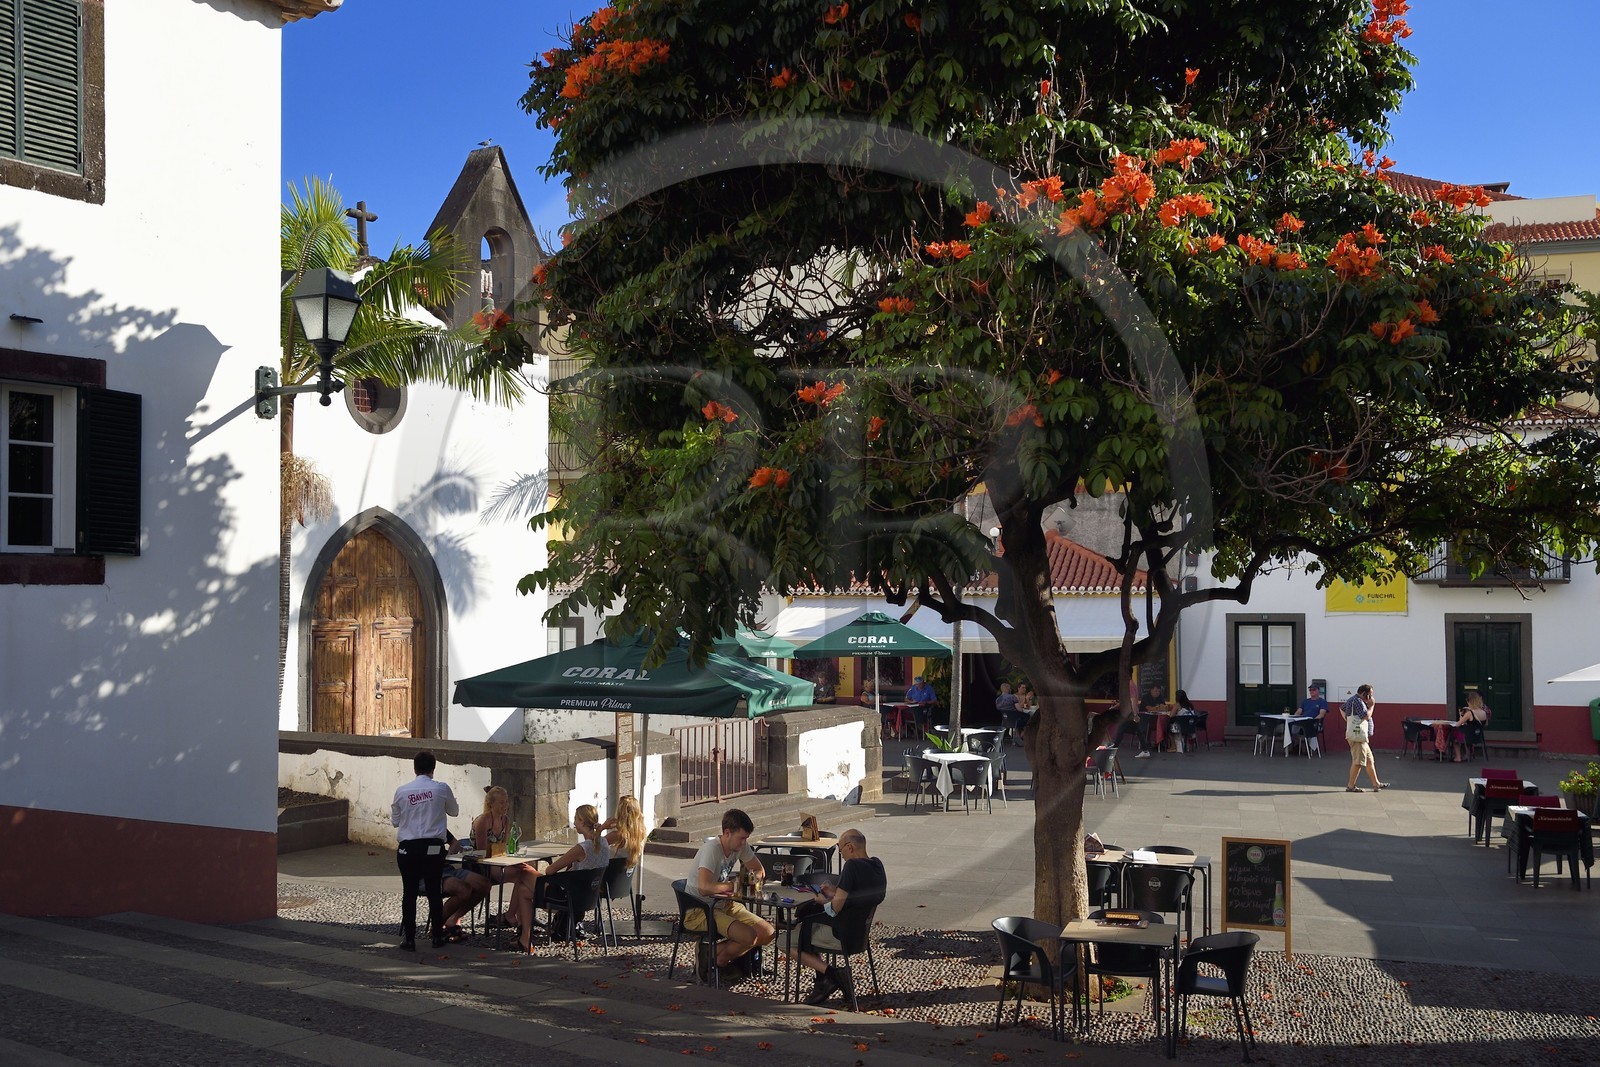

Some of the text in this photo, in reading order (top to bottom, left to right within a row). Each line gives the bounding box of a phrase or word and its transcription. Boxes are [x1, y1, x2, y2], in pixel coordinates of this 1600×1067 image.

[847, 635, 897, 644] CORAL
[561, 666, 651, 681] CORAL
[560, 697, 632, 710] PREMIUM Pilsner
